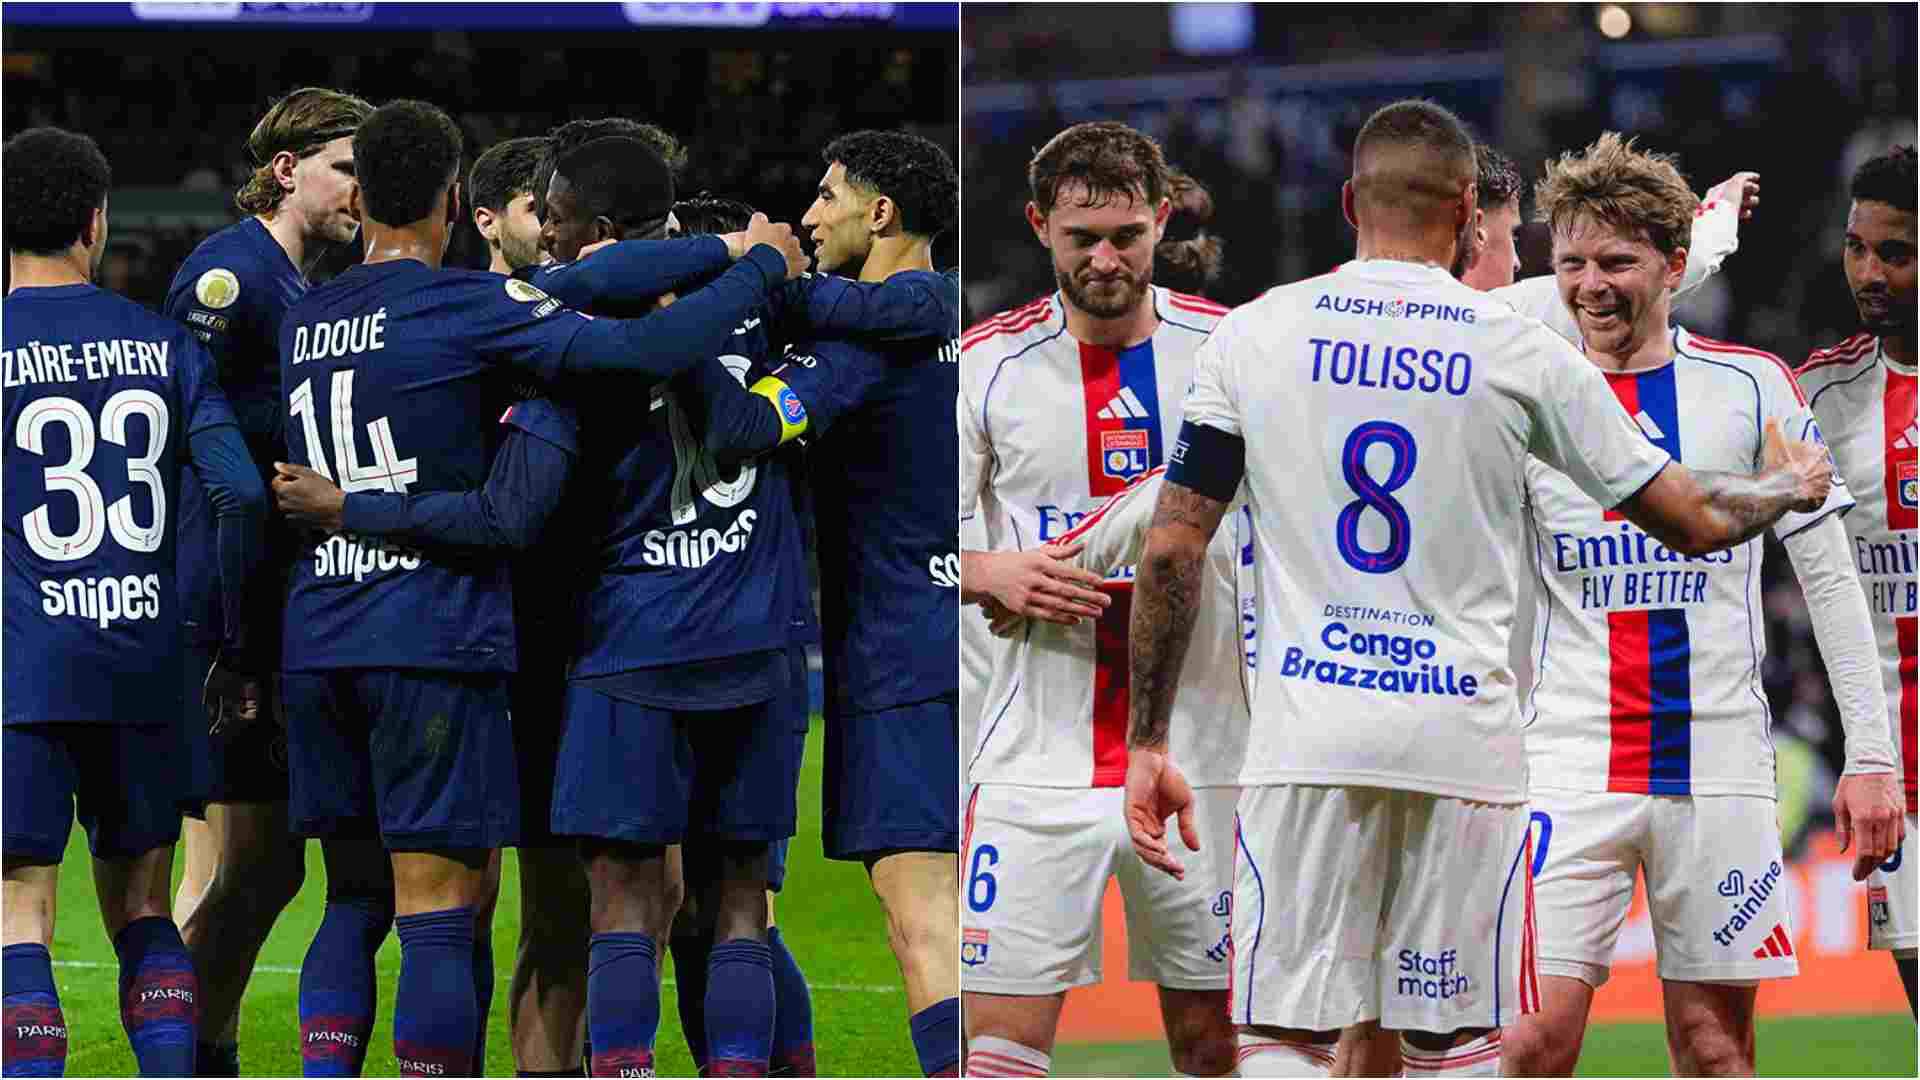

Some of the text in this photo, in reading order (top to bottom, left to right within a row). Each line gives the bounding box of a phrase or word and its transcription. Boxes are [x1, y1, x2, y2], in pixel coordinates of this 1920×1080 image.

[292, 307, 387, 365] D.DOUÉ
[1, 339, 169, 388] ZAÏRE-EMERY
[1308, 338, 1473, 396] TOLISSO
[289, 369, 418, 494] 14
[15, 388, 169, 561] 33
[1336, 420, 1417, 574] 8
[40, 573, 160, 629] snipes
[1581, 570, 1707, 609] FLY BETTER
[1872, 581, 1897, 613] FLY
[1324, 604, 1435, 627] DESTINATION
[1321, 622, 1436, 665] Congo
[1280, 646, 1478, 697] Brazzaville
[967, 843, 999, 914] 6
[1713, 859, 1783, 947] trainline
[1398, 949, 1457, 975] Staff
[141, 988, 193, 1004] PARIS
[17, 1024, 66, 1039] PARIS
[308, 1031, 358, 1048] PARIS
